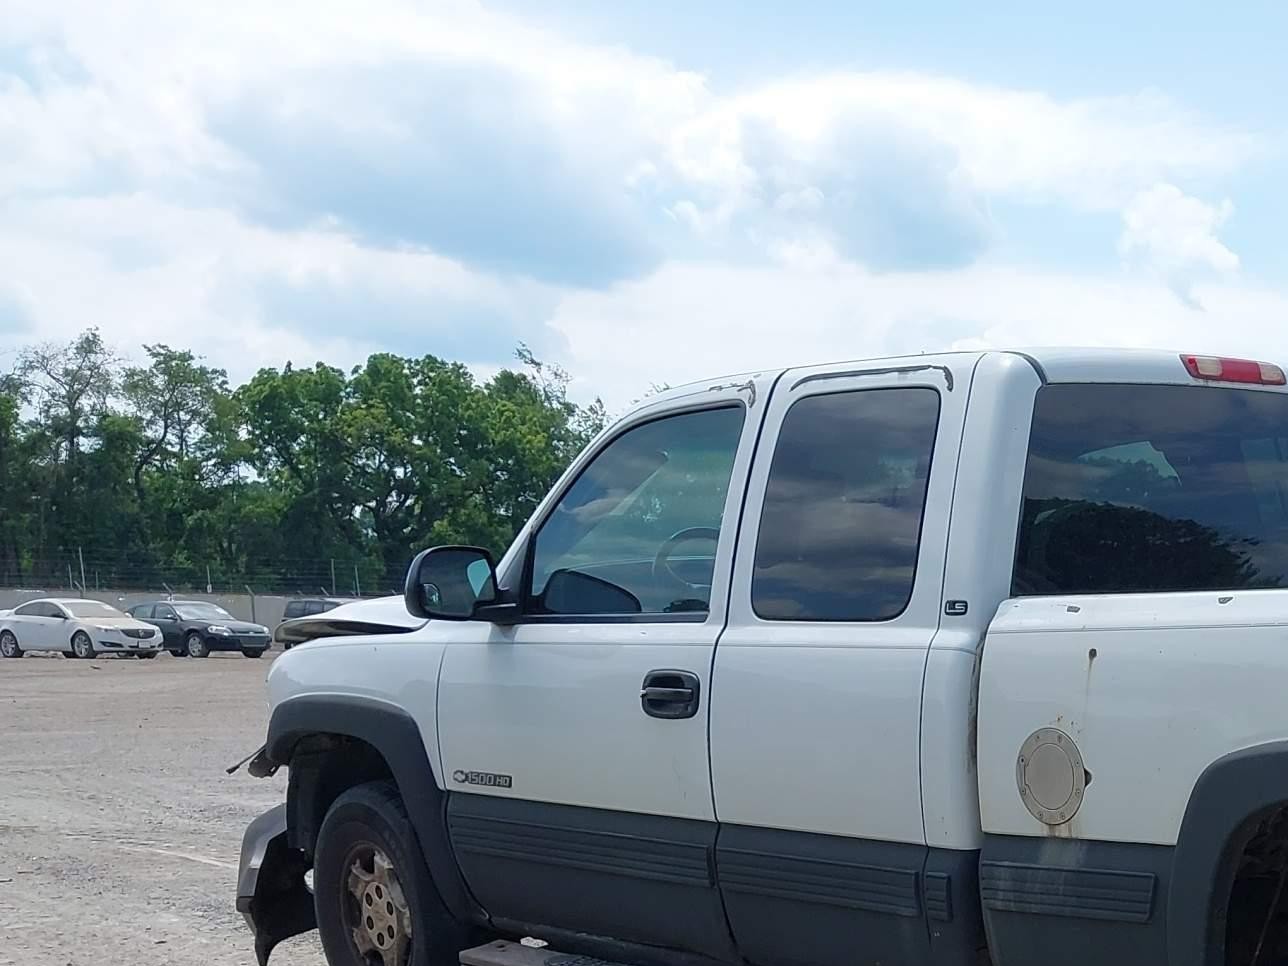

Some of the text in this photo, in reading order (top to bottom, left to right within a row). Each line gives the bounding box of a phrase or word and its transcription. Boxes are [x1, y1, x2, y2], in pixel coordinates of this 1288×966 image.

[945, 602, 966, 613] LS
[467, 772, 510, 787] 1500 HD
